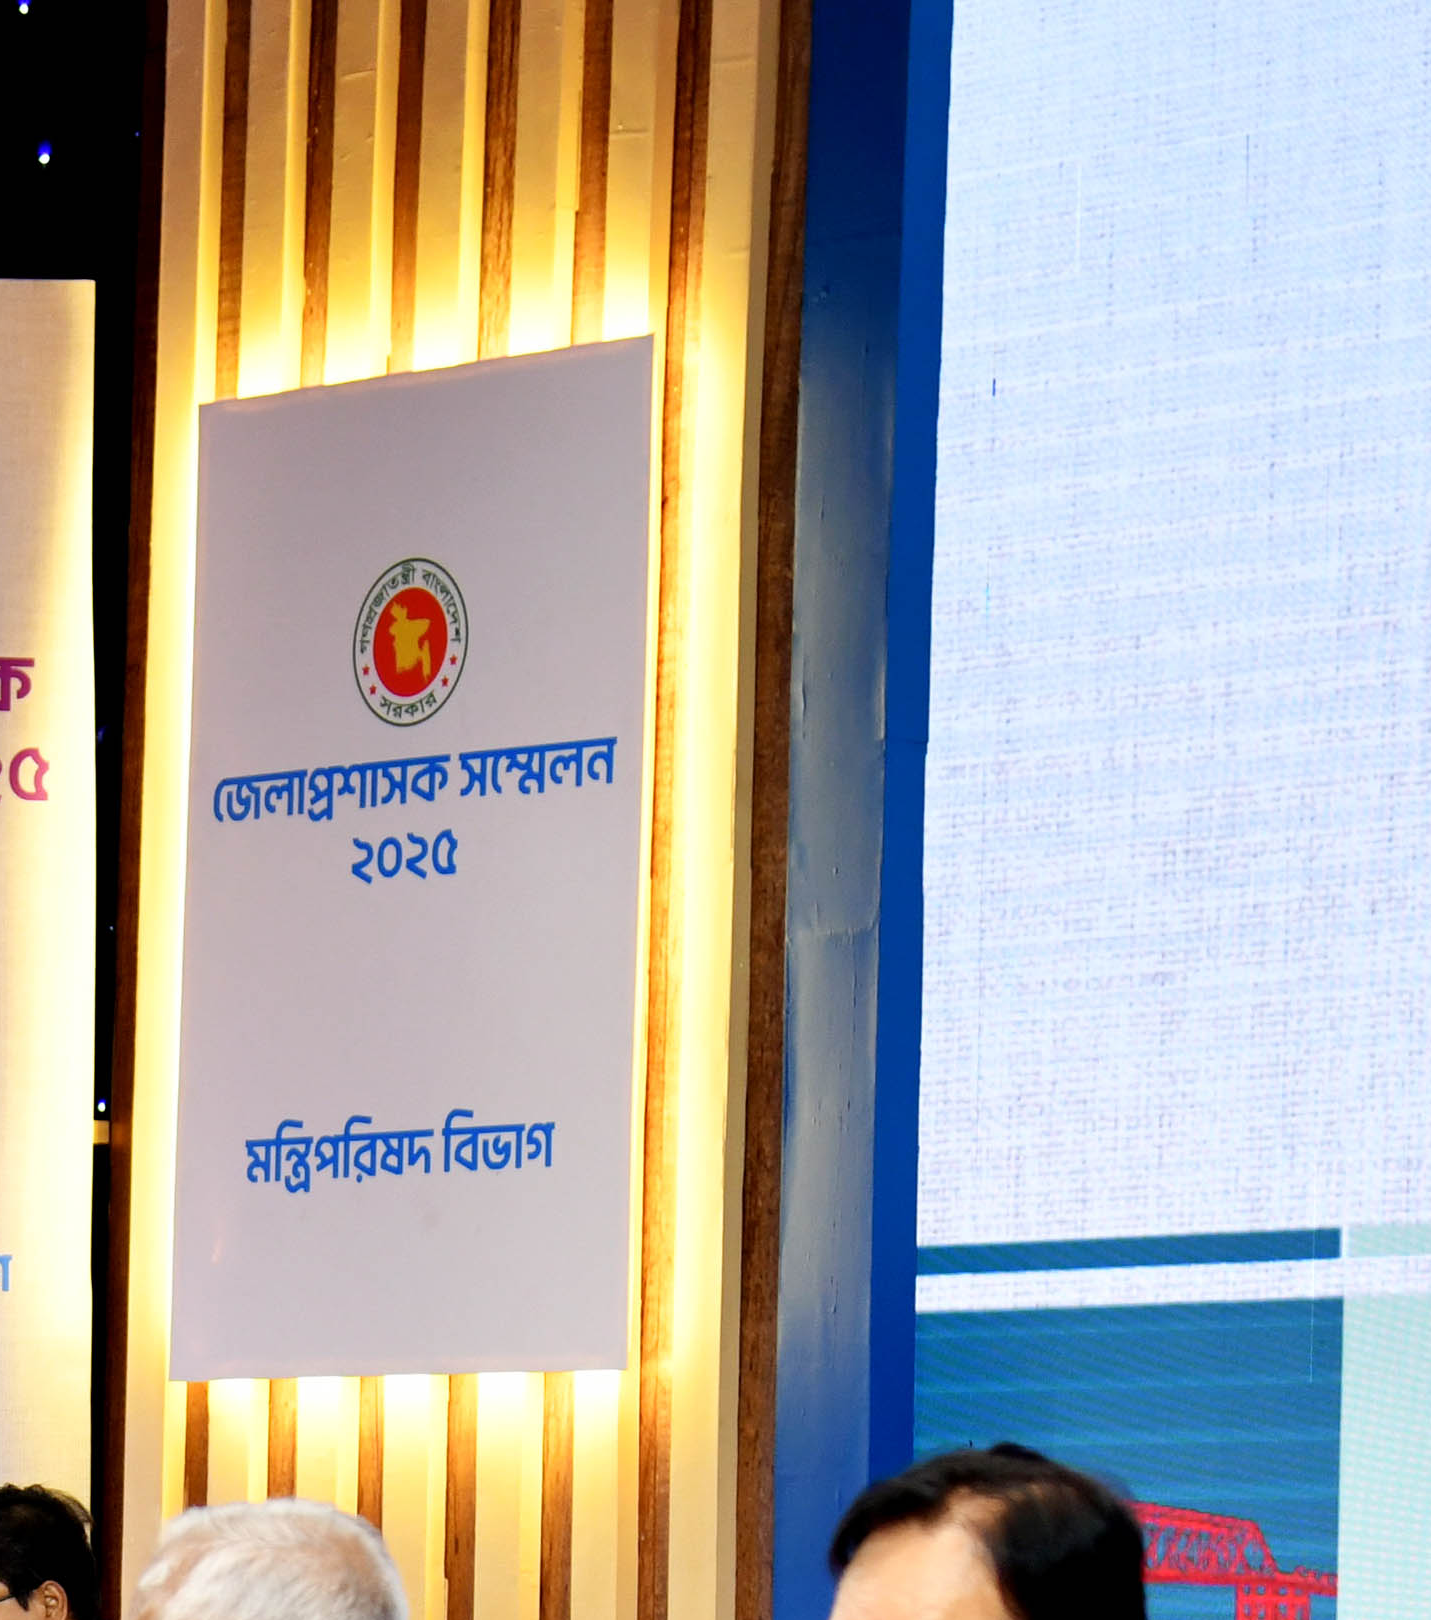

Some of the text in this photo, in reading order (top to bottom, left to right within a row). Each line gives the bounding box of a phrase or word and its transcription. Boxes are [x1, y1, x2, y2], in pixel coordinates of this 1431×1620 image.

[422, 569, 462, 644] বাংলাদেশ
[213, 737, 619, 823] জেলাপ্রশাসক সম্মেলন
[351, 829, 459, 885] ২০২৫
[245, 1108, 556, 1194] মন্ত্রিপরিষদ বিভাগ
